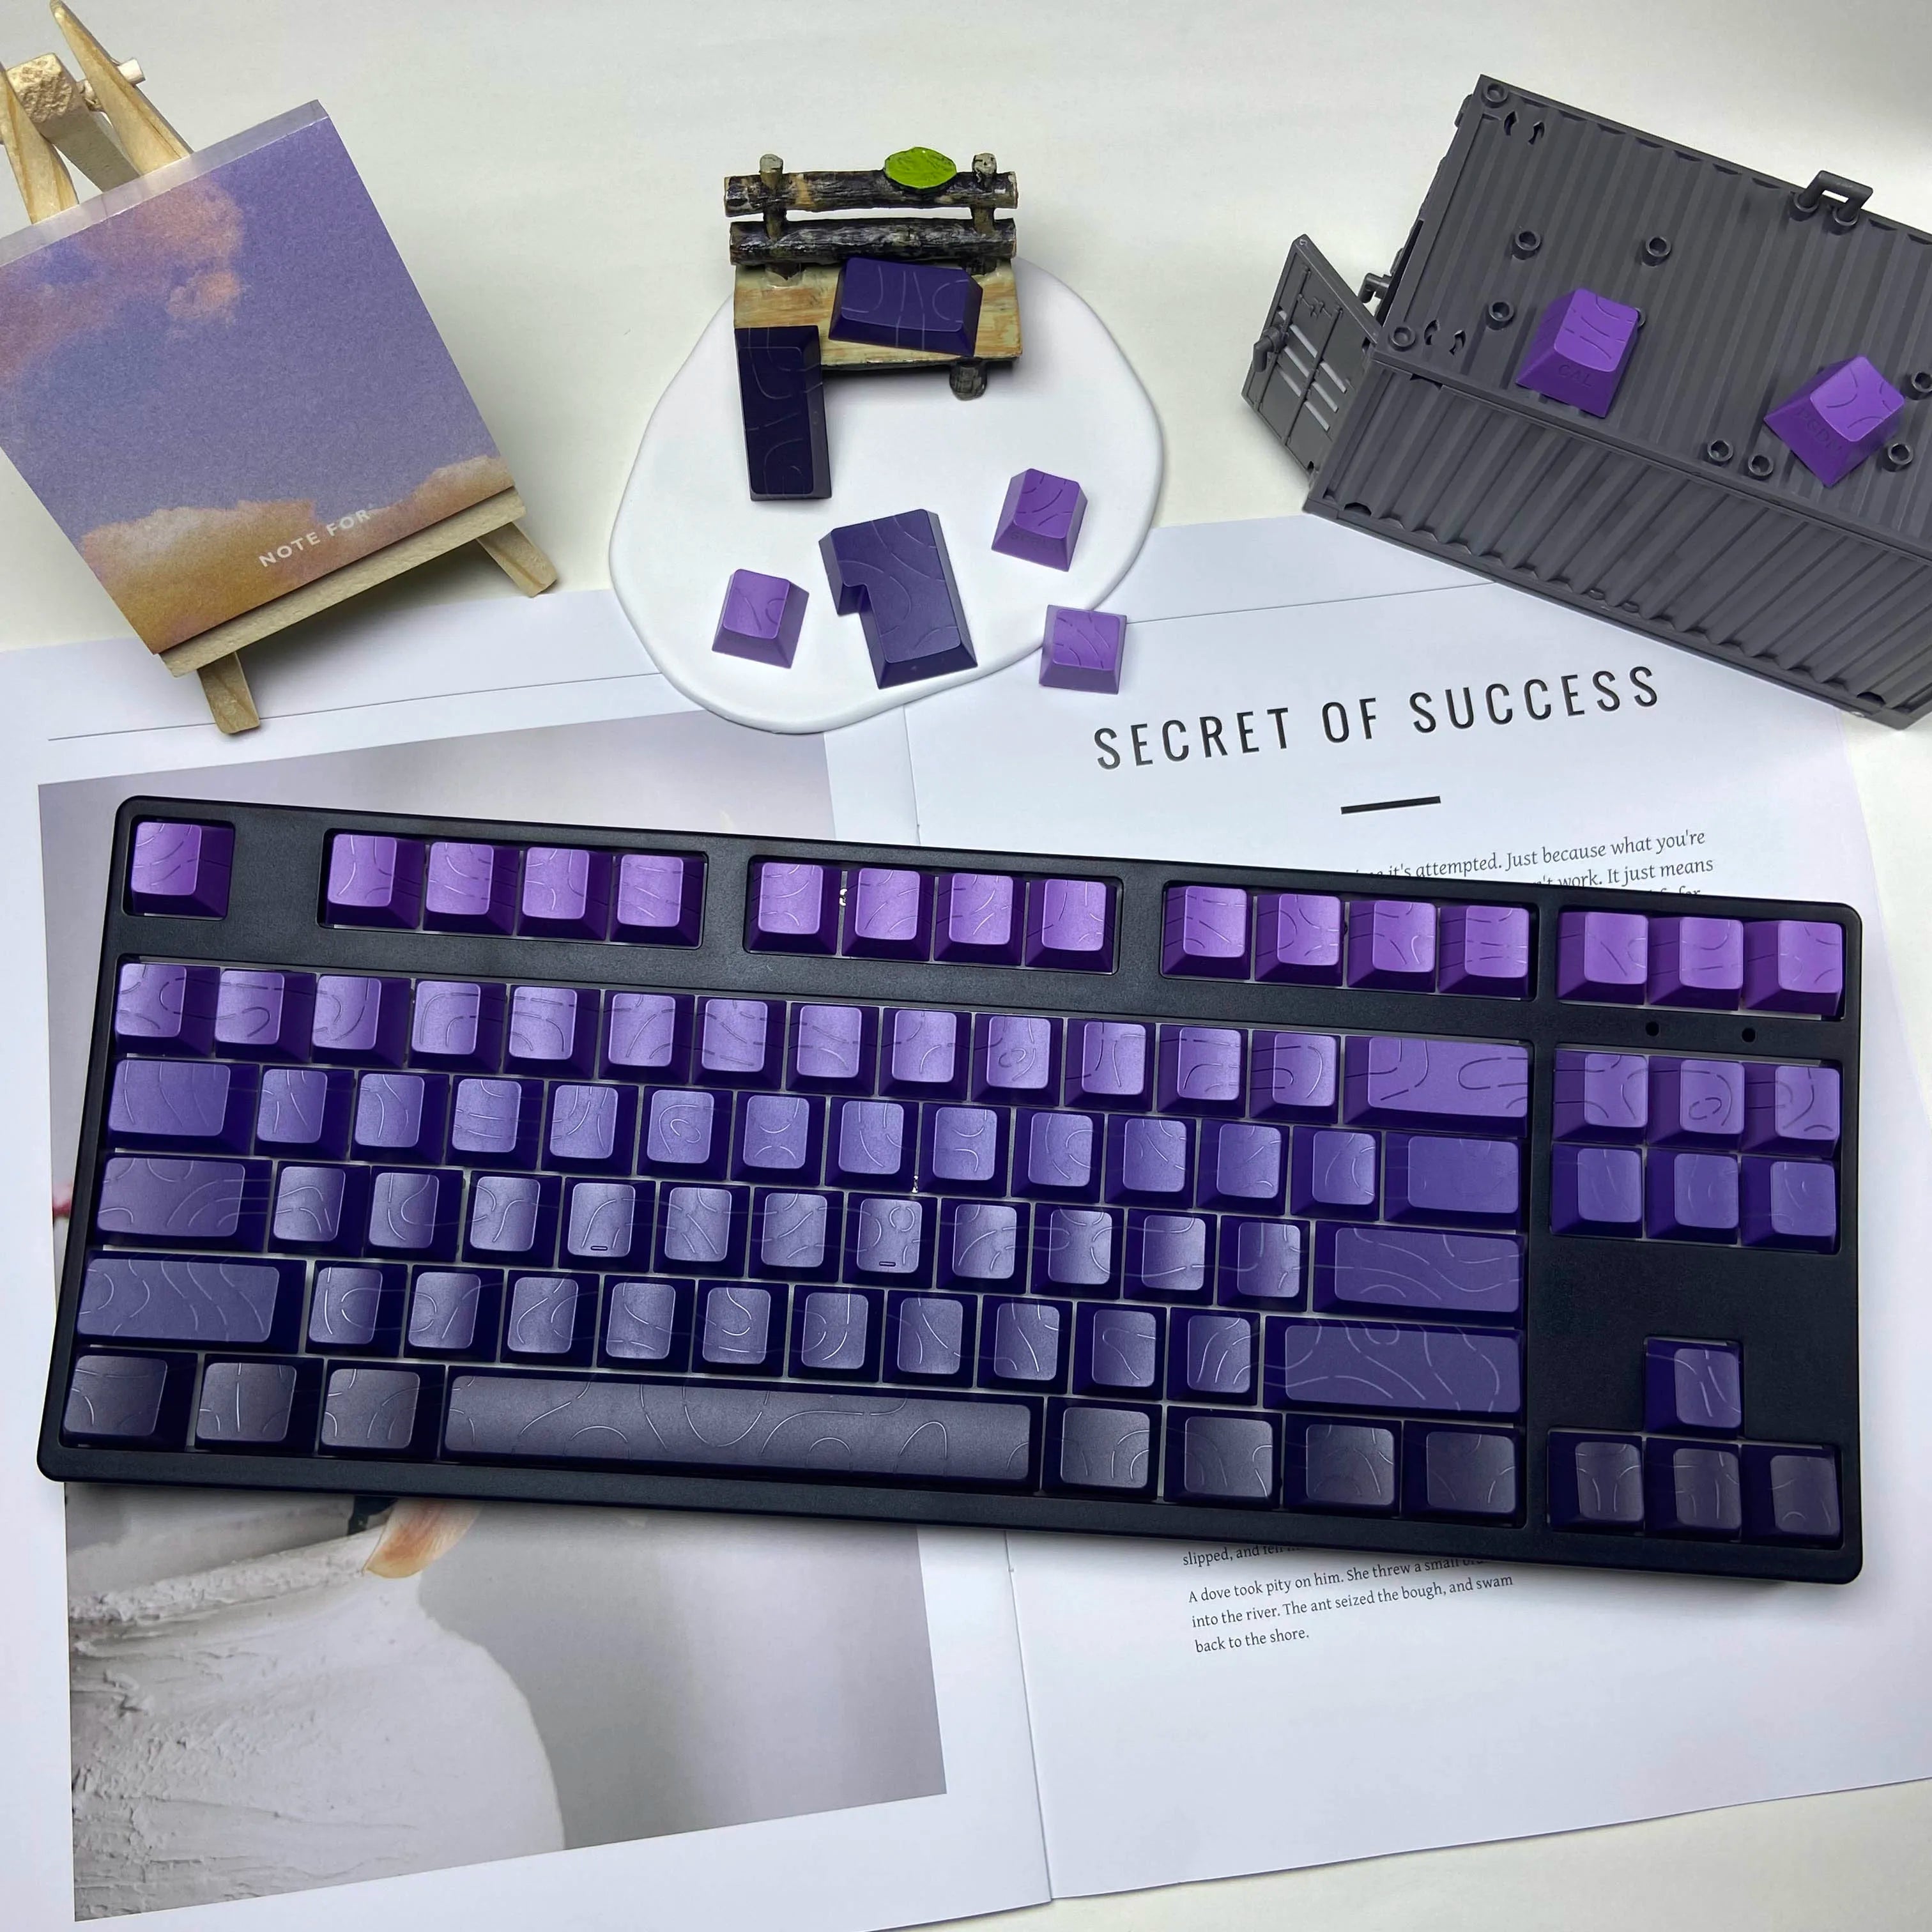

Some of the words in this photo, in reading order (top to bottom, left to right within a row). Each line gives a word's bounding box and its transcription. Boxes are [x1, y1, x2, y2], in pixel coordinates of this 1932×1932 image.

[259, 532, 321, 567] NOTE
[326, 509, 371, 536] FOR
[1093, 706, 1289, 770] SECRET
[1321, 696, 1377, 744] OF
[1409, 665, 1658, 734] SUCCESS
[1416, 852, 1501, 877] attempted.
[1505, 851, 1538, 871] Just
[1542, 845, 1606, 863] because
[1610, 836, 1652, 855] what
[1656, 829, 1705, 855] you're
[1558, 869, 1602, 887] work.
[1607, 868, 1620, 884] It
[1622, 864, 1656, 887] just
[1660, 859, 1713, 877] means
[1183, 1547, 1233, 1567] slipped,
[1236, 1545, 1259, 1558] and
[1189, 1591, 1198, 1603] A
[1201, 1586, 1230, 1600] dove
[1234, 1580, 1263, 1597] took
[1266, 1578, 1291, 1595] pity
[1295, 1576, 1312, 1588] on
[1314, 1572, 1344, 1587] him.
[1347, 1567, 1369, 1581] She
[1372, 1563, 1411, 1577] threw
[1414, 1561, 1422, 1572] a
[1425, 1558, 1459, 1571] small
[1192, 1614, 1218, 1627] into
[1222, 1609, 1243, 1623] the
[1246, 1604, 1281, 1619] river.
[1283, 1601, 1307, 1616] The
[1311, 1598, 1332, 1611] ant
[1335, 1590, 1375, 1608] seized
[1377, 1588, 1399, 1602] the
[1402, 1582, 1446, 1599] bough,
[1450, 1577, 1473, 1593] and
[1476, 1575, 1513, 1590] swam
[1195, 1636, 1226, 1653] back
[1229, 1636, 1242, 1648] to
[1245, 1632, 1266, 1646] the
[1270, 1629, 1309, 1643] shore.
